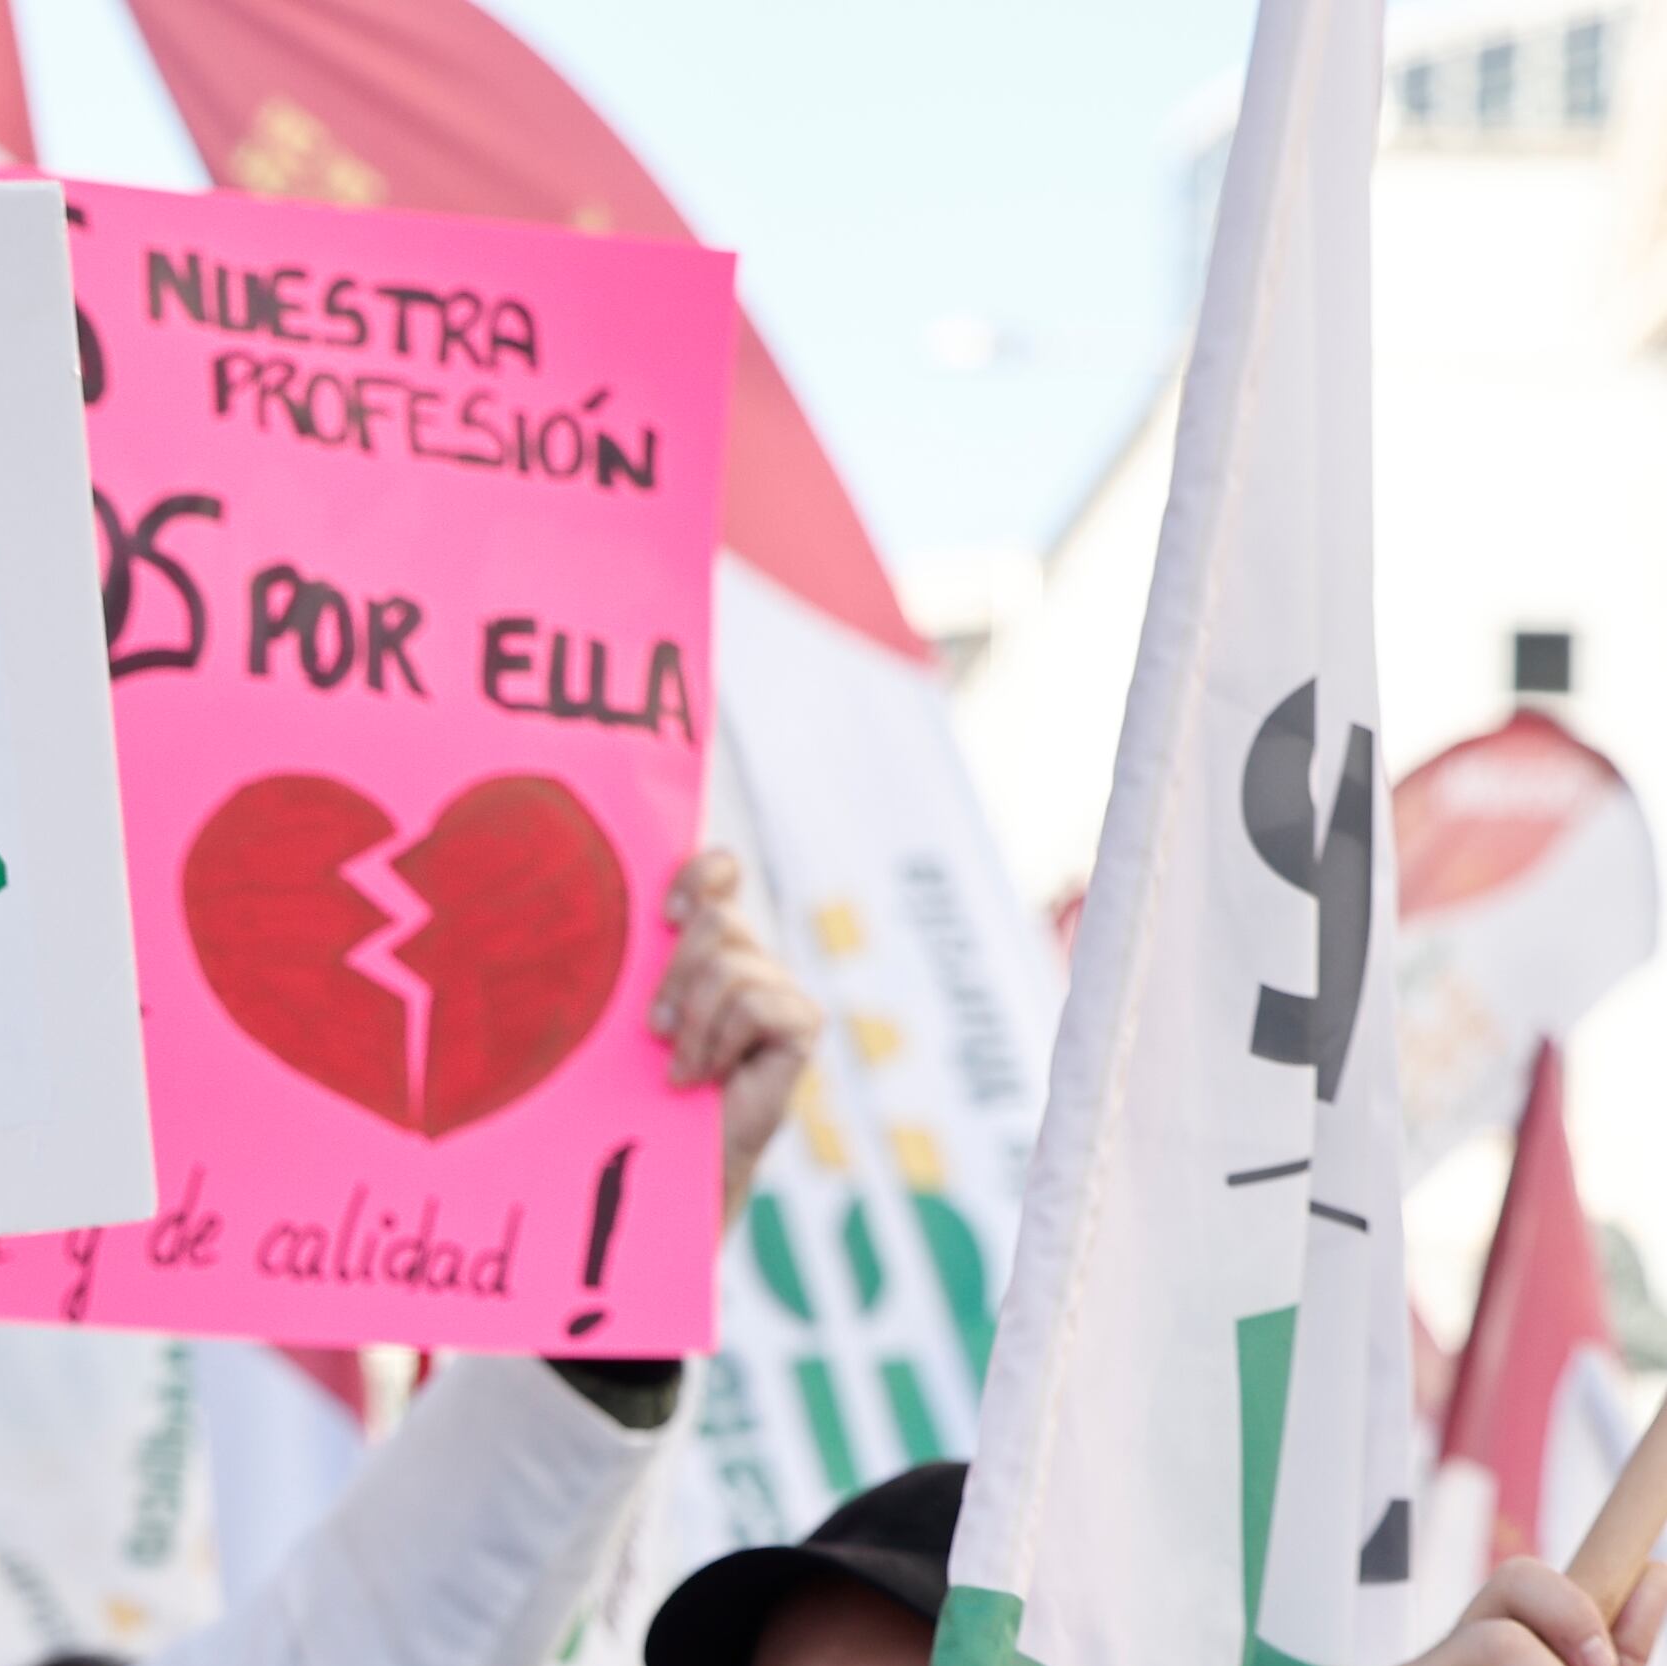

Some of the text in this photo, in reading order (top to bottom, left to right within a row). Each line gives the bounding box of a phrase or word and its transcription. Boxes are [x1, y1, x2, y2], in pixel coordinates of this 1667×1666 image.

[144, 250, 538, 369] NUESTRA
[213, 350, 659, 489] PROFESIÓN
[246, 563, 431, 700] POR
[480, 617, 694, 743] ELLA
[146, 1162, 222, 1270] de
[257, 1183, 525, 1298] calidad
